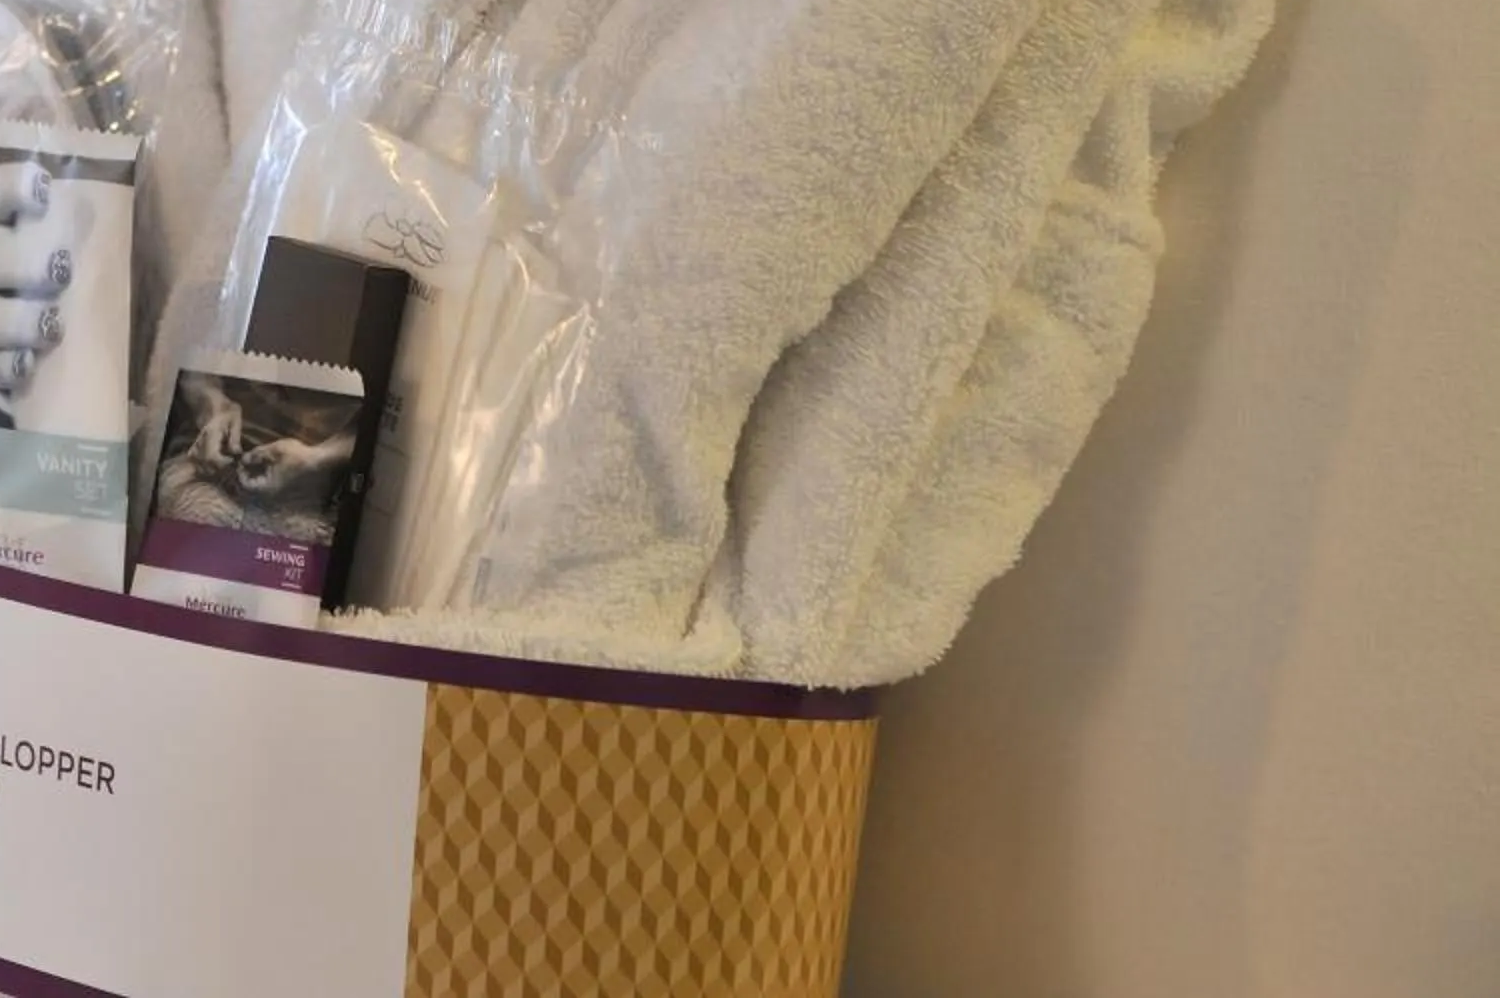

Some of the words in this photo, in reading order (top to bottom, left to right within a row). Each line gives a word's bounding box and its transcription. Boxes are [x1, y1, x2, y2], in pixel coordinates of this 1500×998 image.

[36, 451, 109, 480] VANITY
[74, 480, 108, 502] SET
[254, 547, 306, 568] SEWING
[284, 566, 305, 581] KIT
